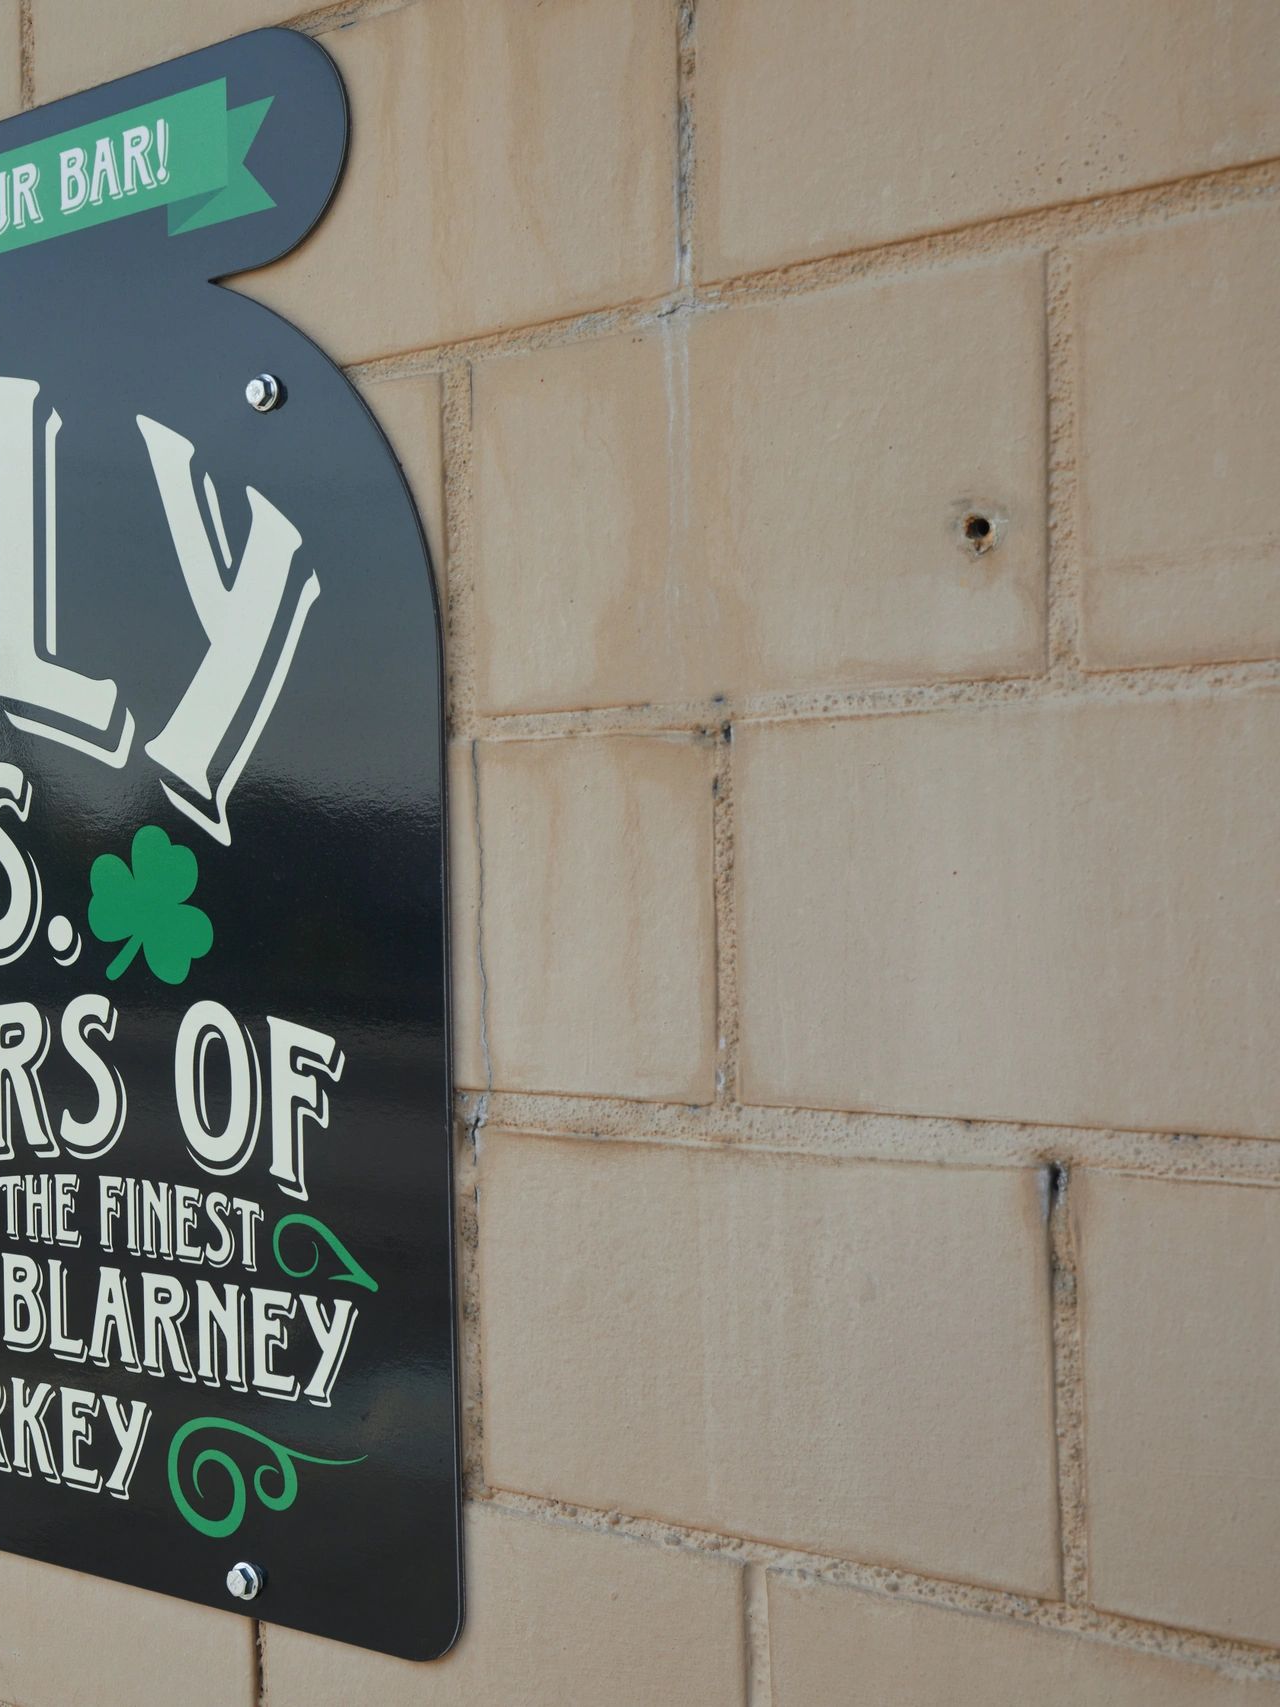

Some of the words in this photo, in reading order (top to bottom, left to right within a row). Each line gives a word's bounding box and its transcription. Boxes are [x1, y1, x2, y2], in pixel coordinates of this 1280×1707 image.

[60, 119, 168, 214] BAR!
[175, 1001, 345, 1201] OF
[0, 1174, 81, 1248] THE
[99, 1176, 264, 1271] FINEST
[2, 1253, 358, 1407] BLARNEY
